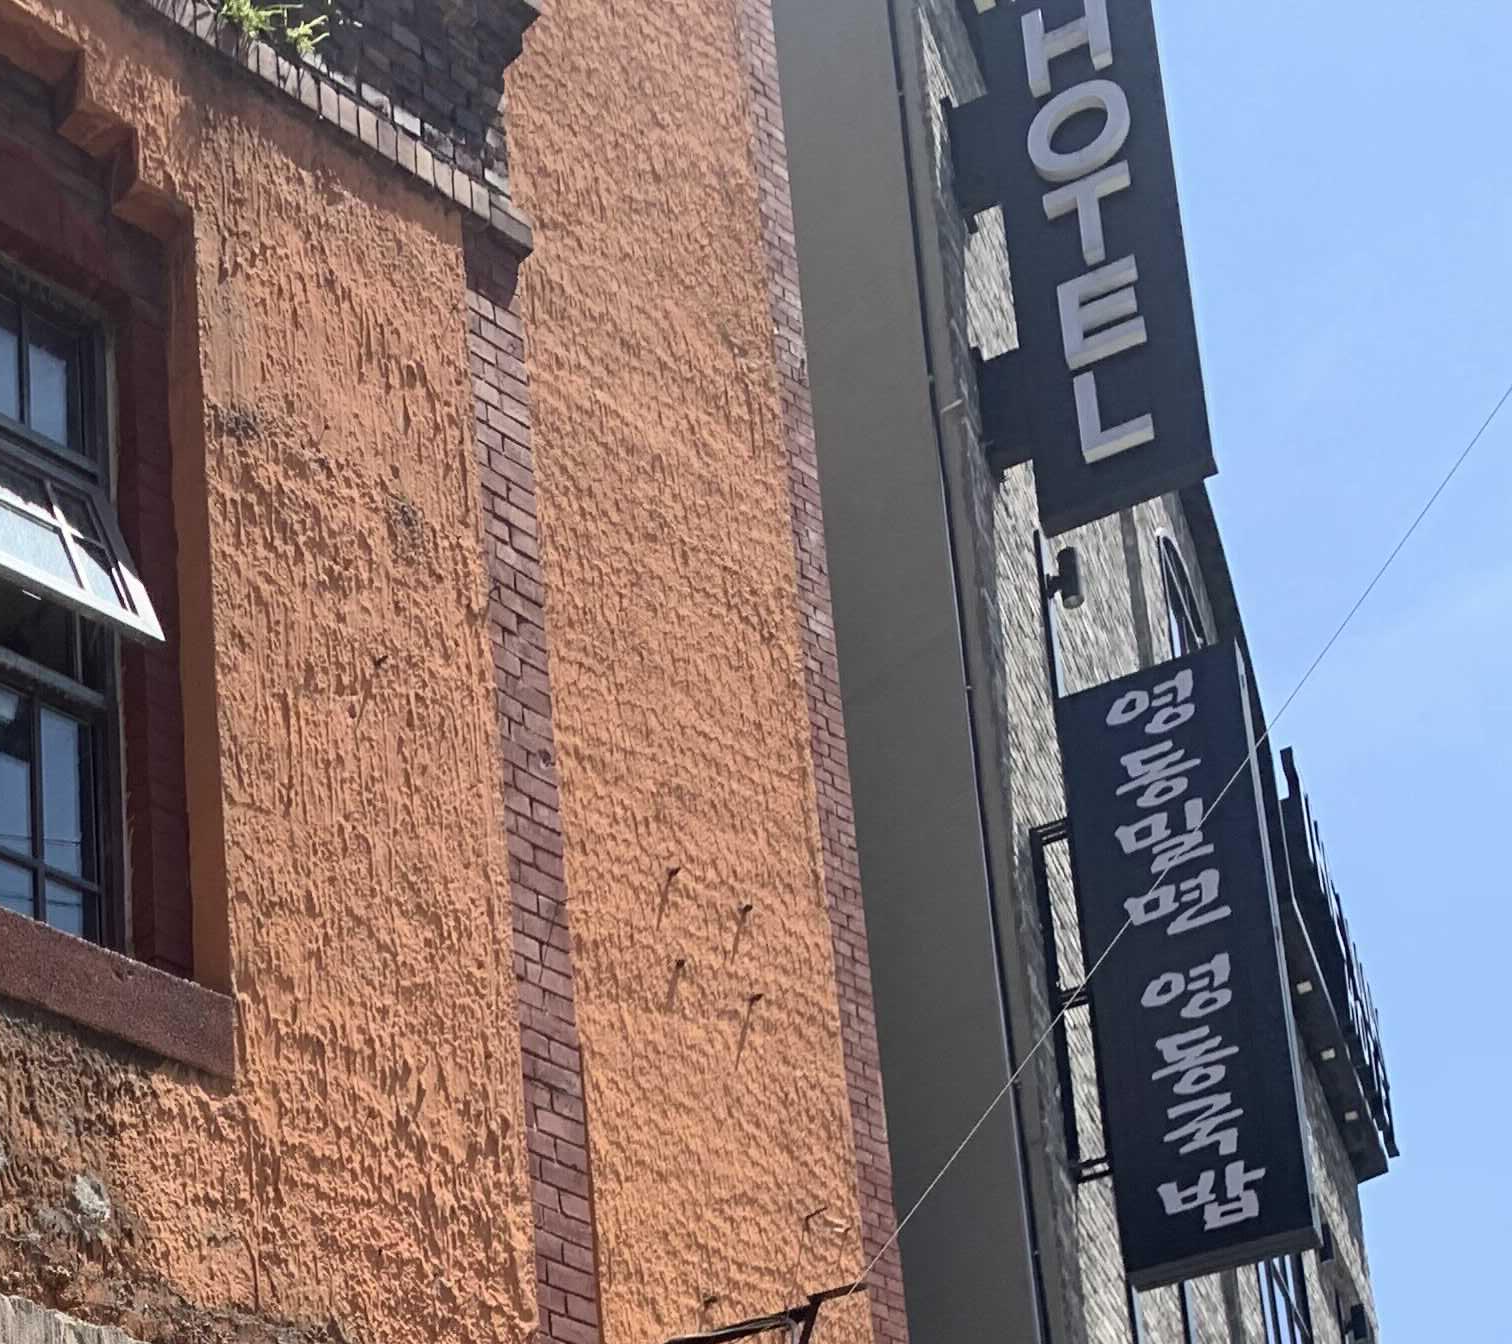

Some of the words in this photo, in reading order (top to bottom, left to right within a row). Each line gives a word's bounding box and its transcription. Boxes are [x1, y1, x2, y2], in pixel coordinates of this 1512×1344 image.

[1021, 0, 1155, 464] HOTEL
[1106, 669, 1232, 935] 영동밀면
[1141, 952, 1266, 1231] 영동국밥
